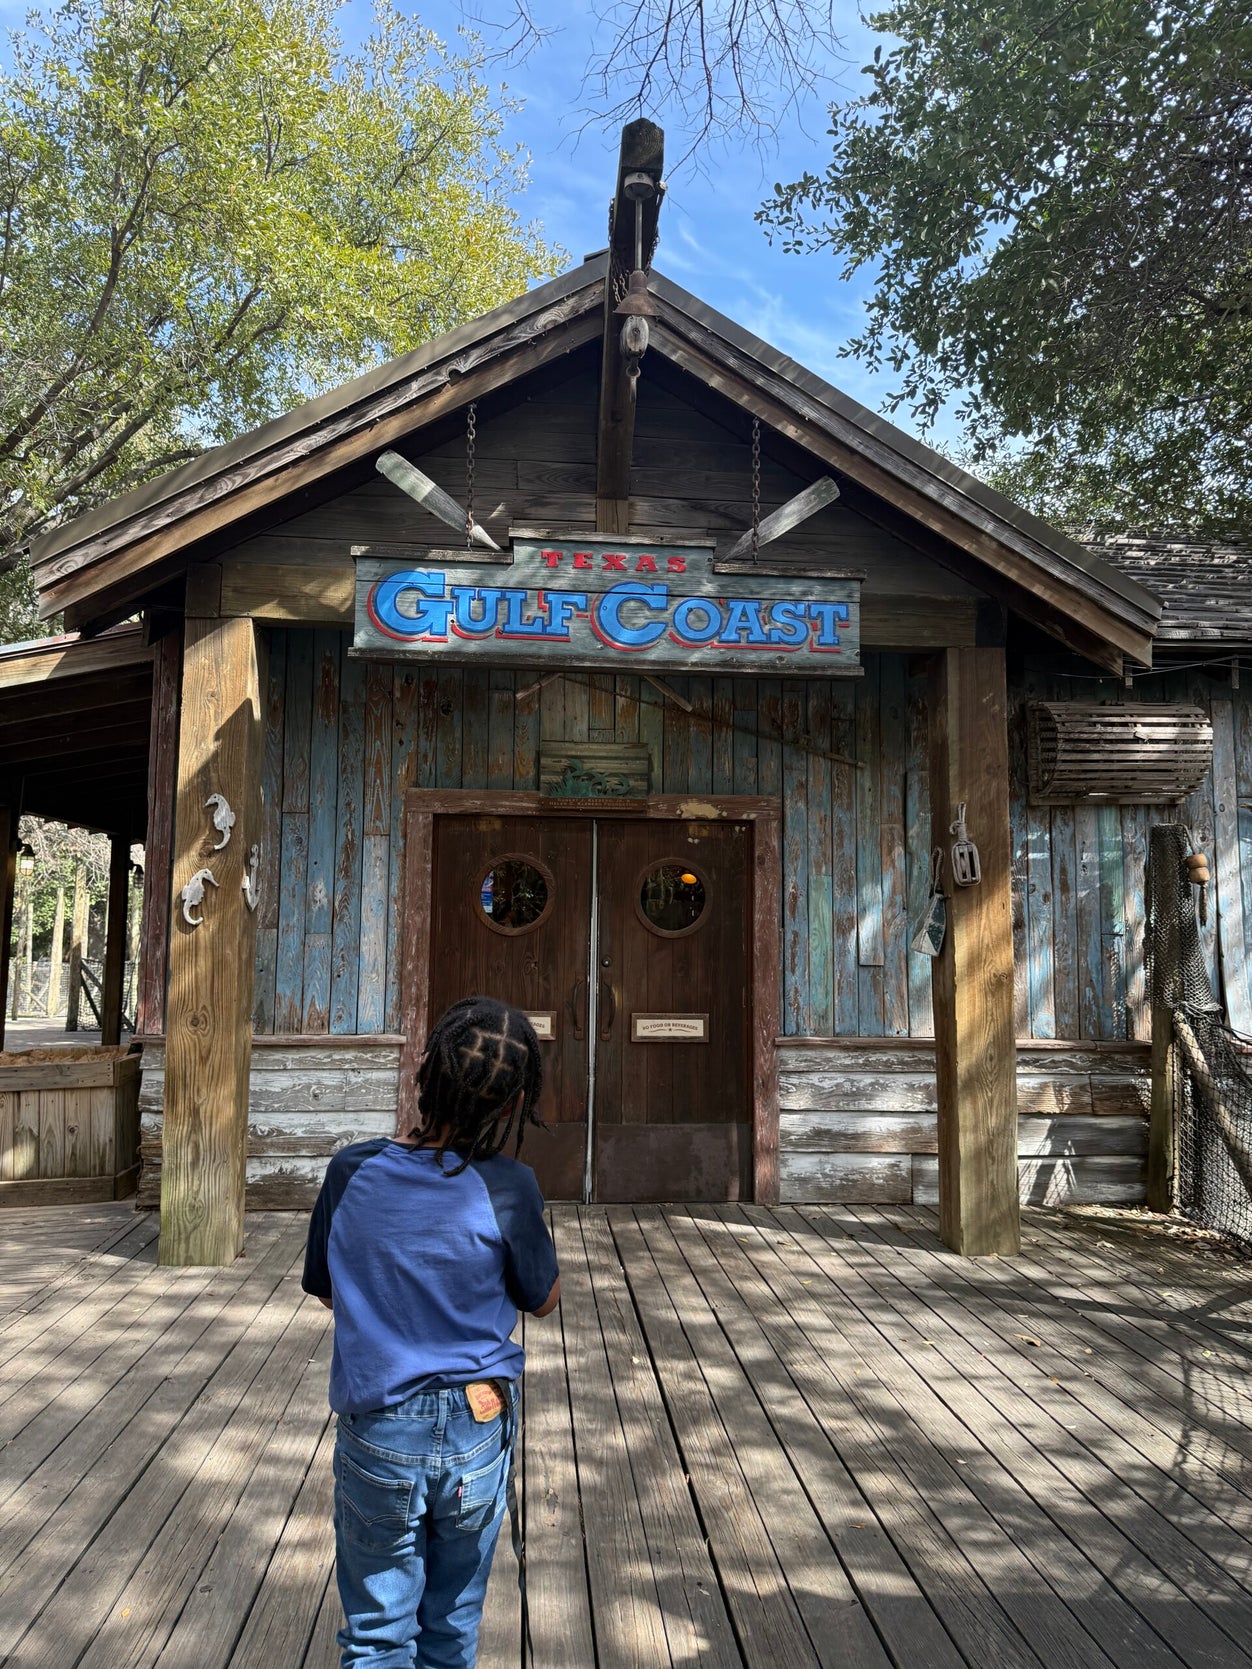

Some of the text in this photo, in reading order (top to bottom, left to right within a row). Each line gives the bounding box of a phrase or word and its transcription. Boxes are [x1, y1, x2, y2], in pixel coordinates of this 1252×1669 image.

[540, 550, 687, 574] TEXAS
[371, 568, 850, 649] GULF COAST
[672, 1022, 698, 1031] BEVERAGES
